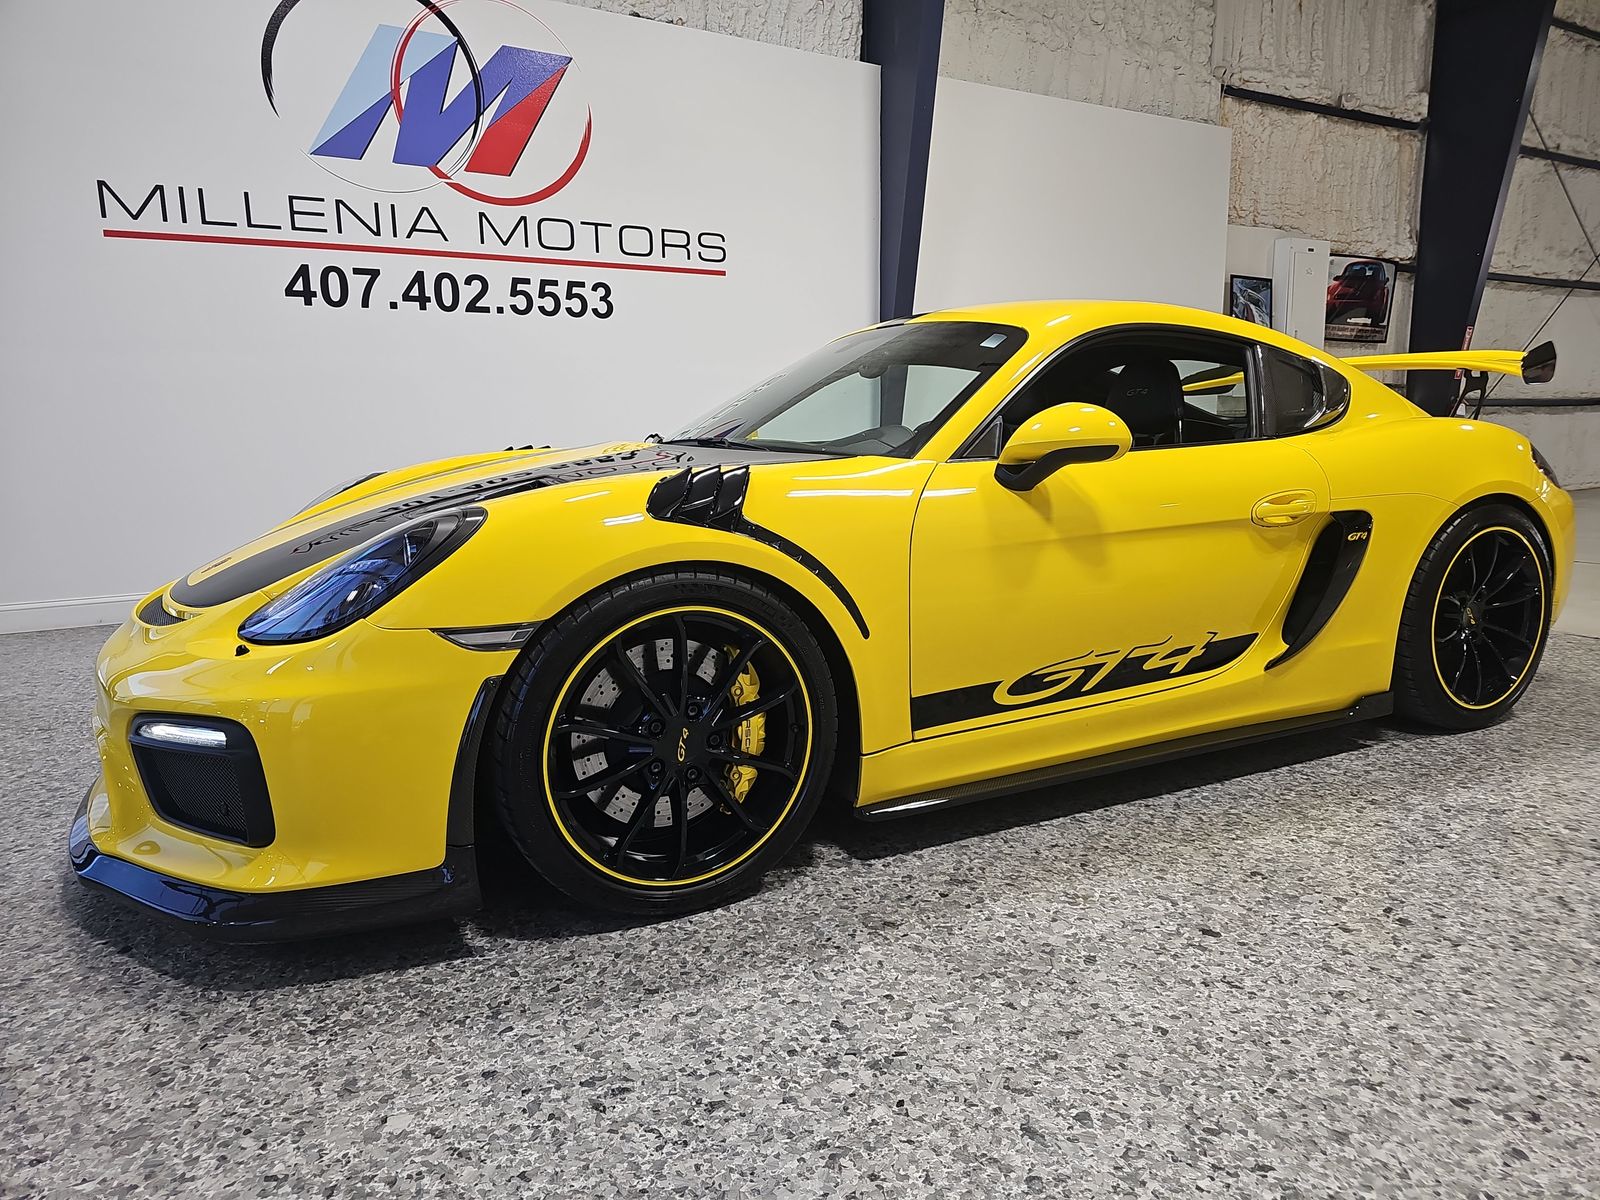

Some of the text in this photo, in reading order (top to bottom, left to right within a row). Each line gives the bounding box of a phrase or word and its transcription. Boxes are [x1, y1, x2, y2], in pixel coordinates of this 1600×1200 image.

[96, 179, 727, 263] MILLENIA MOTORS
[284, 263, 614, 320] 407.402.5553
[1347, 531, 1368, 541] GT4
[992, 632, 1218, 706] GT4
[677, 727, 689, 762] GT4
